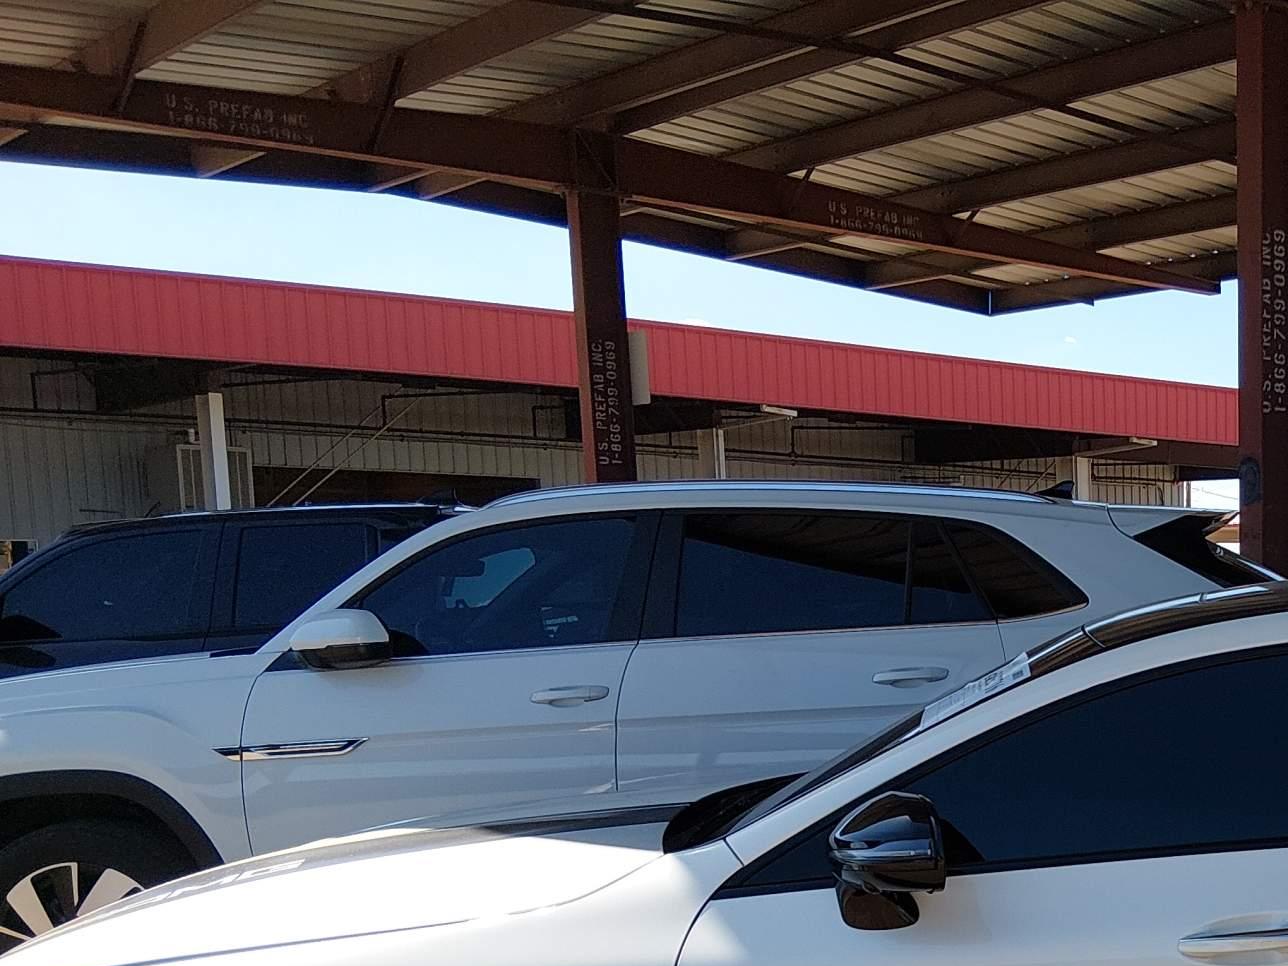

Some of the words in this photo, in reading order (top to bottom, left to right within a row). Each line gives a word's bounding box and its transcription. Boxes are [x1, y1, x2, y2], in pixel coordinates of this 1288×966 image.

[208, 100, 273, 123] PREFAB
[1274, 229, 1286, 412] 1-866-799-0969
[593, 373, 608, 430] PREFAB
[604, 341, 623, 464] 1-866-799-0969
